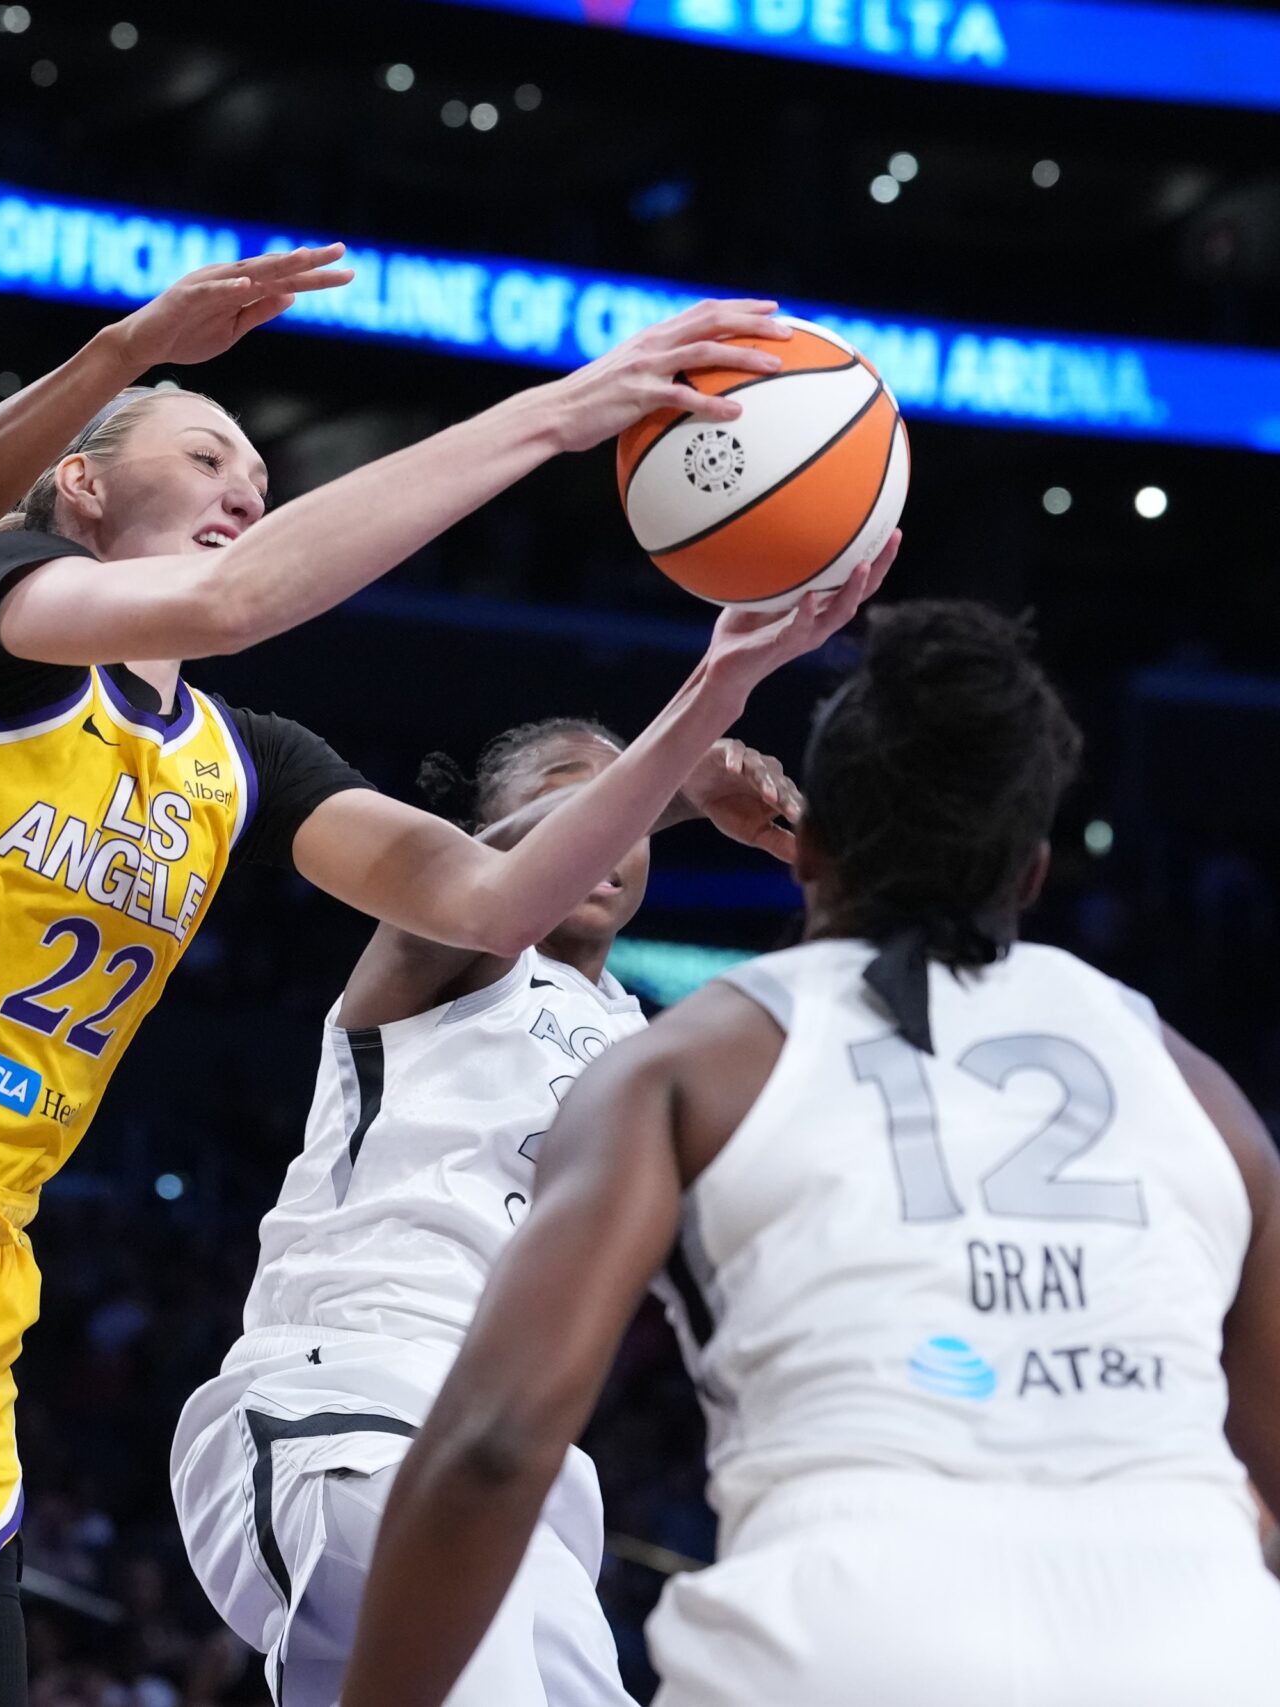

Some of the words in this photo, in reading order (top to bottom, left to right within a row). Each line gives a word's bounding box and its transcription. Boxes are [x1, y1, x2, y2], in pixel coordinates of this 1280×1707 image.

[752, 0, 1008, 68] DELTA
[490, 269, 573, 355] OF
[846, 1032, 1150, 1229] 12
[966, 1239, 1088, 1315] GRAY
